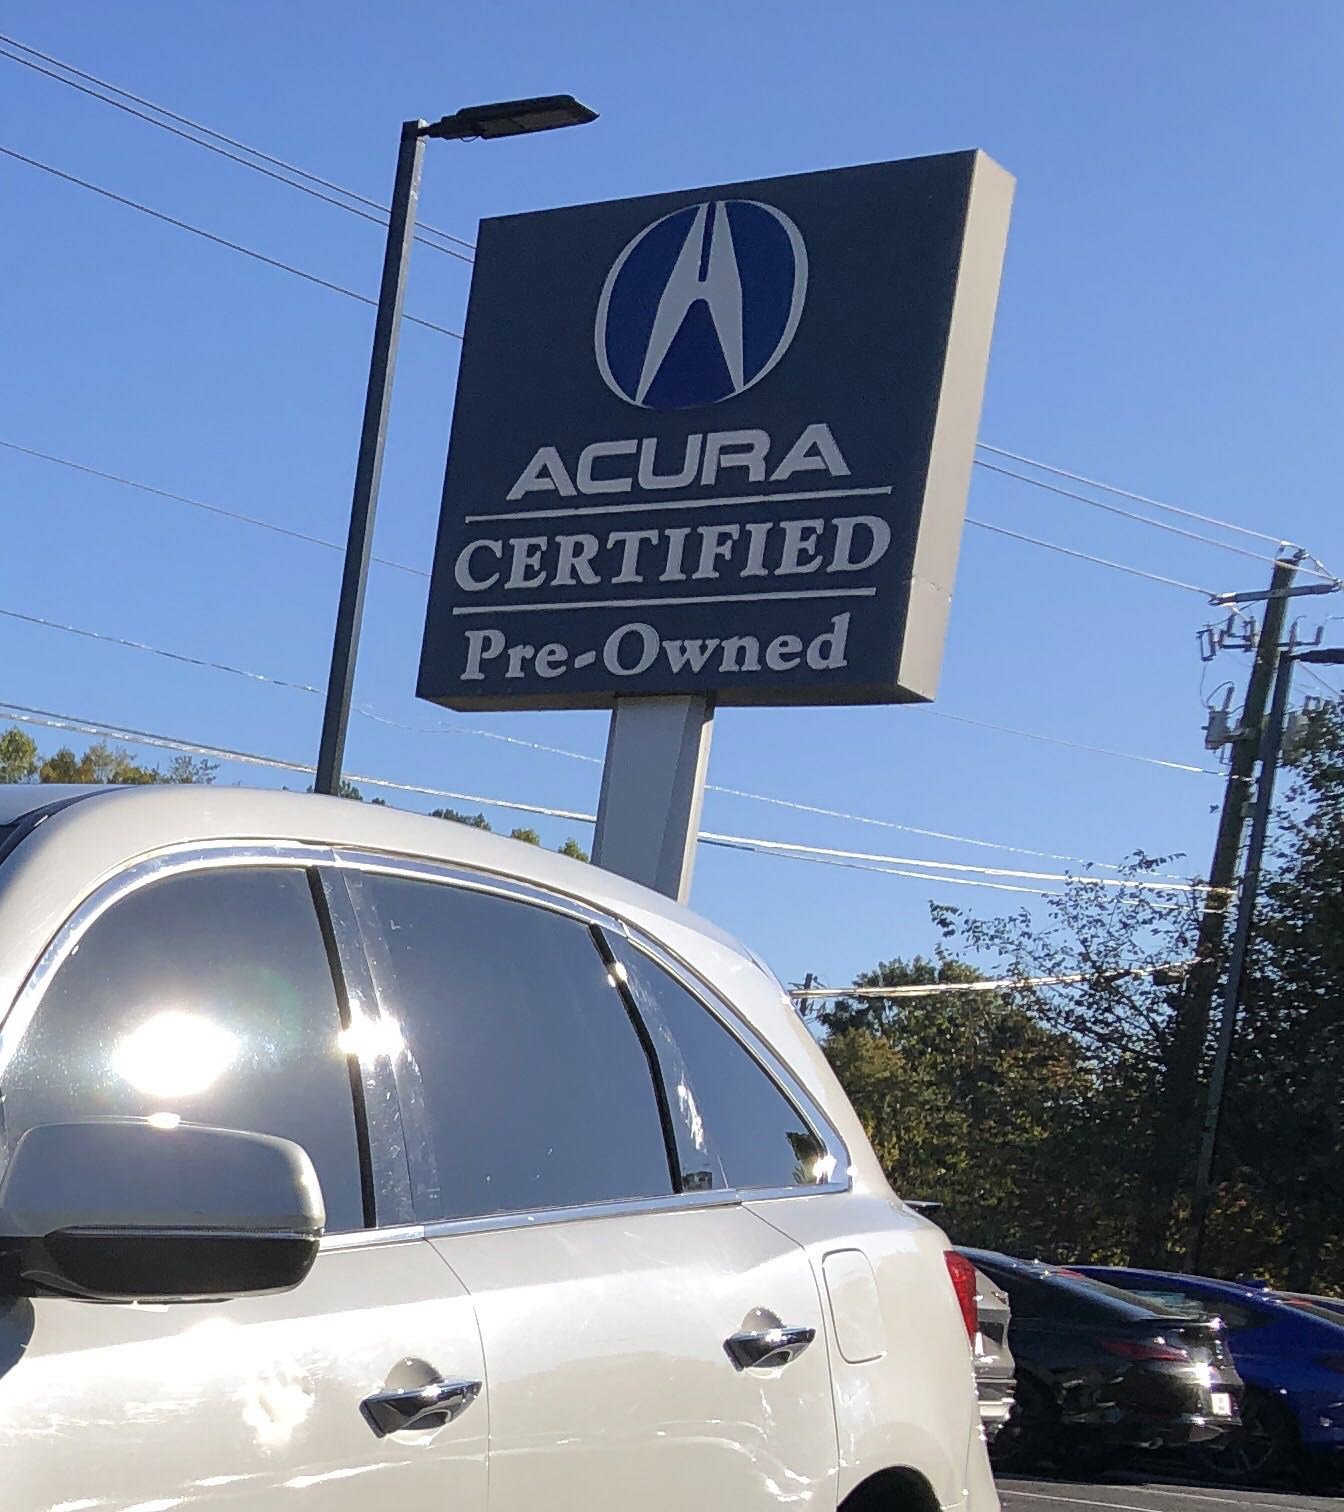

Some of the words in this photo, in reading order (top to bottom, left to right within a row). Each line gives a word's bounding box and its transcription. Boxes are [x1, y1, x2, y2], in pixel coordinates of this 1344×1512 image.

[506, 423, 851, 500] ACURA
[454, 515, 892, 592] CERTIFIED
[459, 612, 851, 681] Pre-Owned
